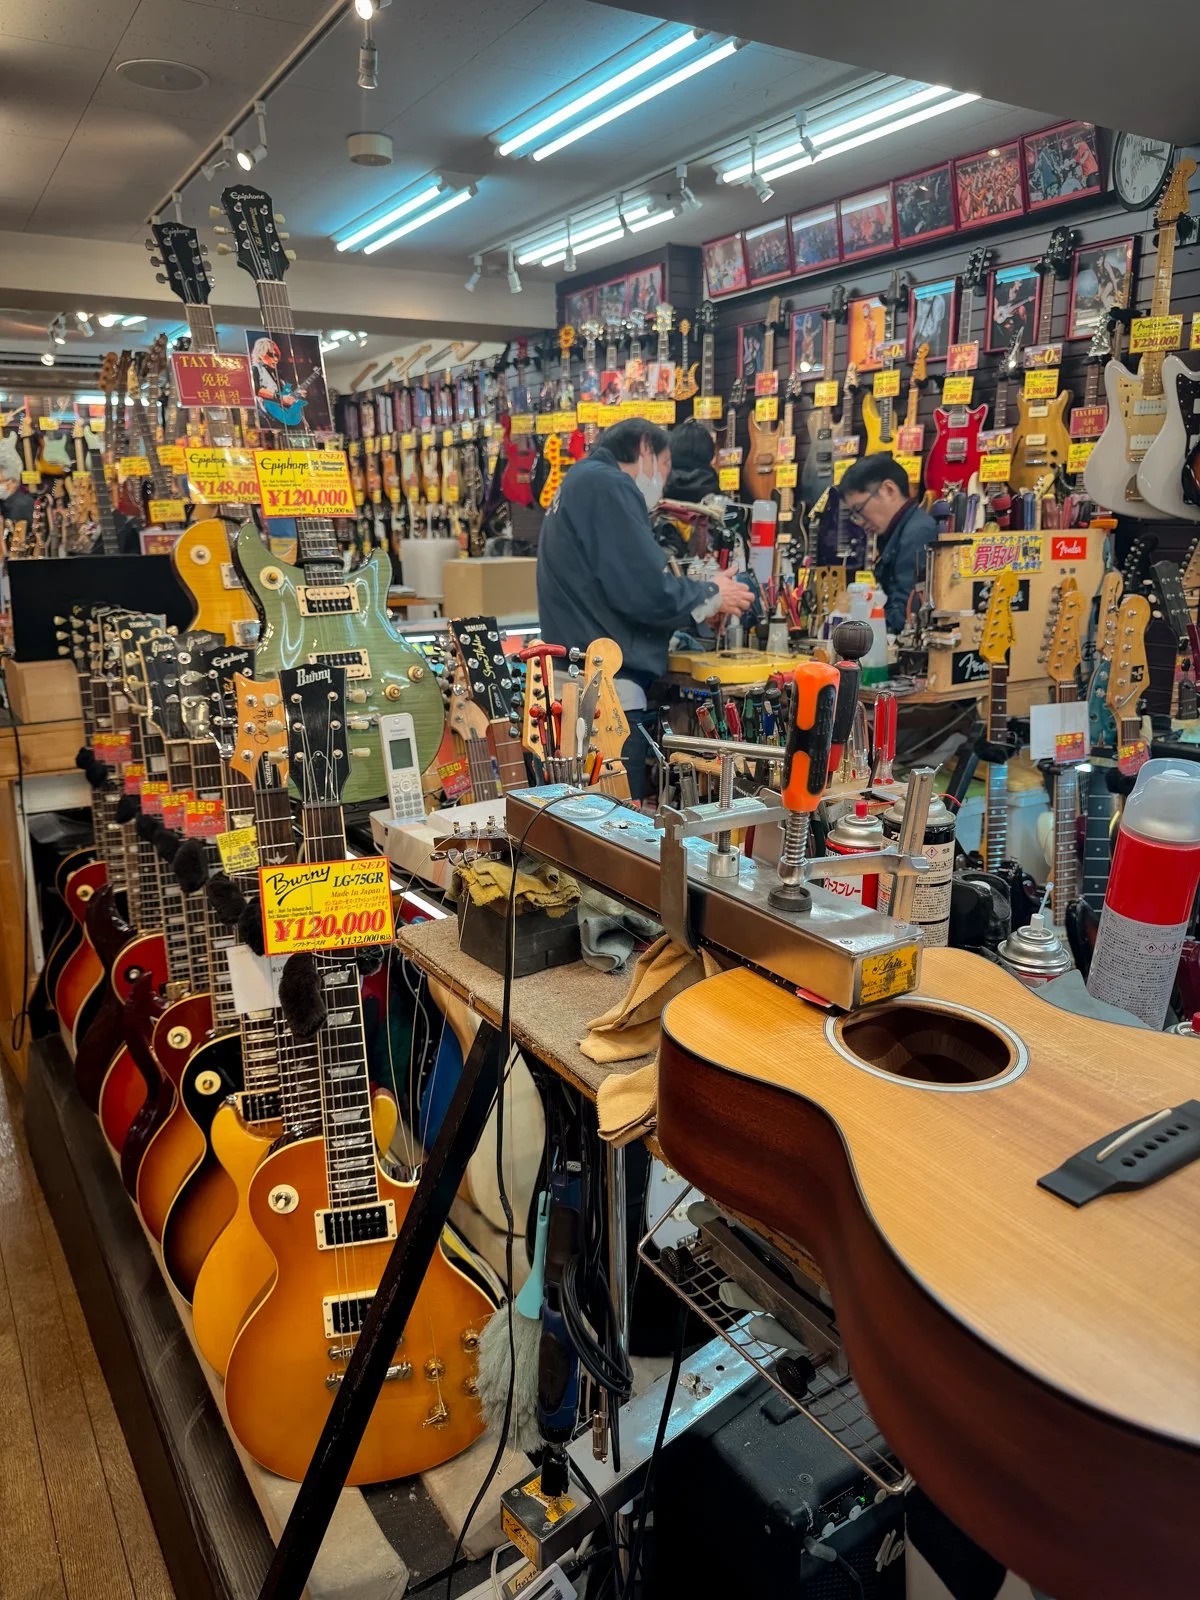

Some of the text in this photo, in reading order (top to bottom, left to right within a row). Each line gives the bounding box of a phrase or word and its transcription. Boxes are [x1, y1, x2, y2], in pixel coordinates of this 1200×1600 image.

[230, 191, 266, 201] Epiphone
[179, 356, 208, 368] TAX
[202, 373, 231, 387] 免税
[260, 457, 309, 475] Epiphone
[267, 489, 348, 506] ¥120,000
[1055, 540, 1082, 556] Fender
[973, 544, 1020, 573] 買取り
[464, 624, 488, 633] YAMAHA
[211, 652, 249, 669] Epiphone
[351, 861, 385, 871] USED
[266, 866, 330, 906] Burny
[333, 871, 384, 888] LG-75GR
[331, 890, 349, 898] Made
[360, 888, 380, 897] Japan
[274, 909, 386, 942] ¥120,000
